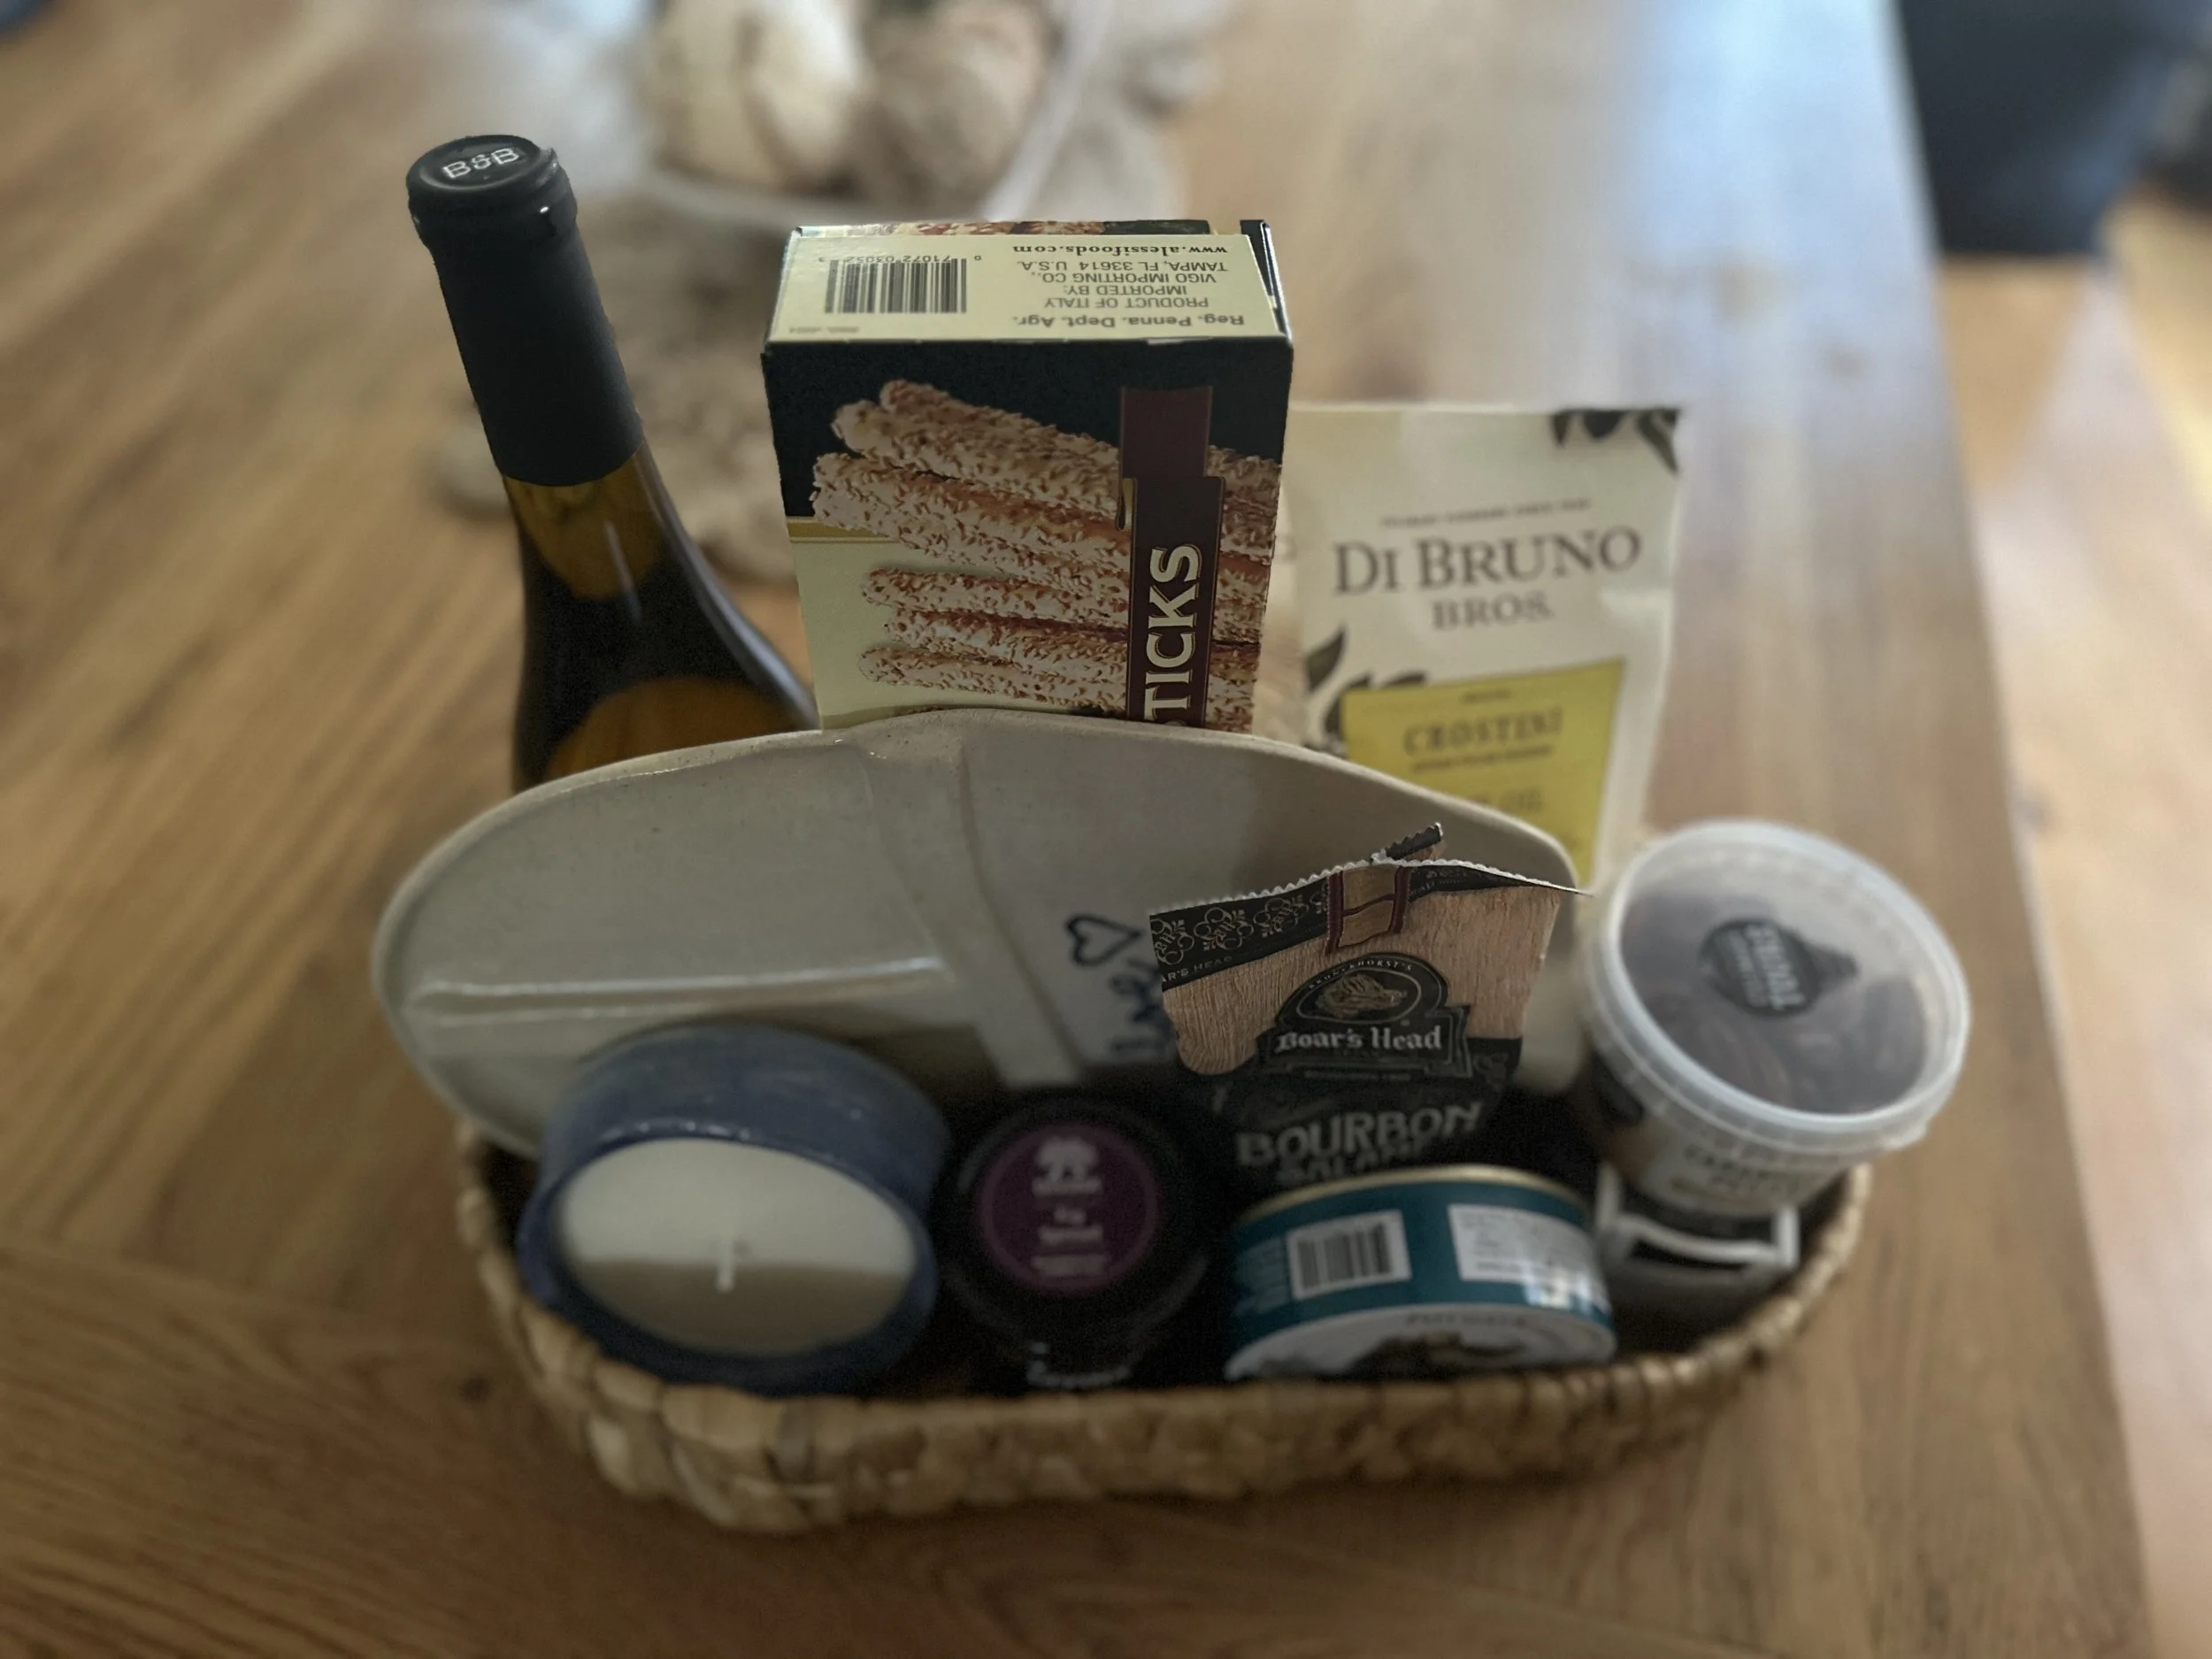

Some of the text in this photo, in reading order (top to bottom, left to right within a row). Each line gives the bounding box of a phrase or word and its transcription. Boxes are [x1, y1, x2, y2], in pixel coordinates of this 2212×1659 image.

[1012, 245, 1227, 257] www.alessifoods.com
[1018, 260, 1228, 272] TAMPA, FL 33614 U.S.A.
[1073, 273, 1170, 283] IMPORTING
[1175, 273, 1217, 283] VIGO
[1063, 286, 1187, 296] IMPORTED BY:
[1044, 297, 1209, 308] PRODUCT OF ITALY
[1013, 313, 1245, 328] Reg. Penna. Dept. Agr.
[1417, 526, 1643, 591] BRUNO
[1431, 590, 1555, 632] BROS.
[1144, 543, 1202, 726] TICKS
[1194, 956, 1233, 972] HEAD
[1273, 1024, 1442, 1055] Boar's Head
[1237, 1100, 1483, 1167] BOURBON
